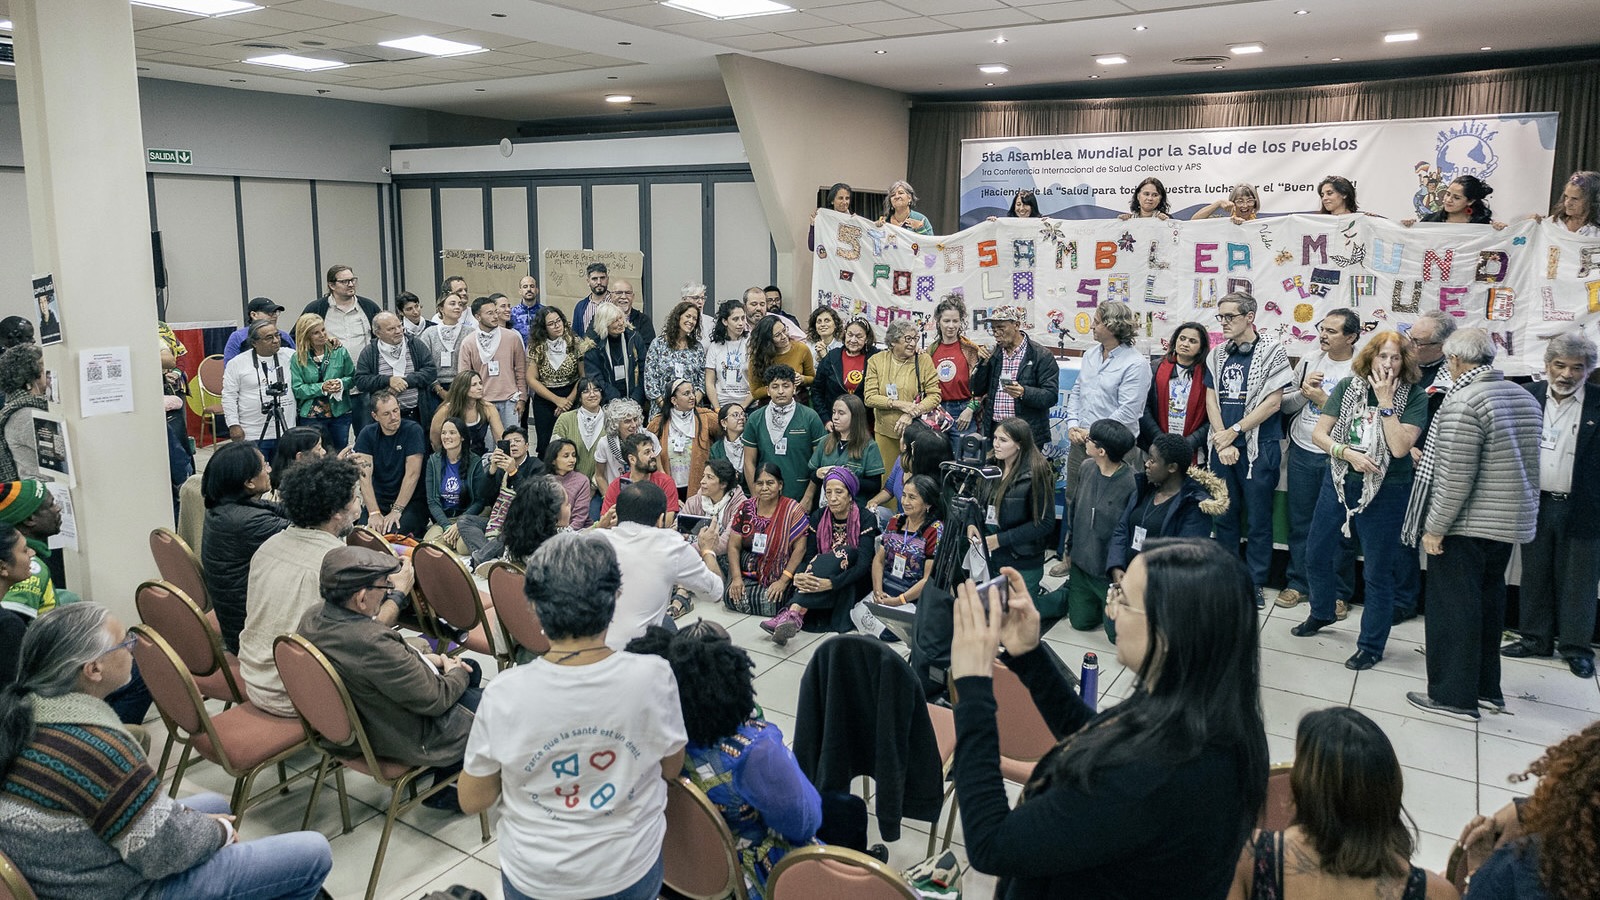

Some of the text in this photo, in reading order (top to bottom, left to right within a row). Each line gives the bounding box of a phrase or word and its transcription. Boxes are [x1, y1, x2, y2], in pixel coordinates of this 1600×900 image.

[150, 152, 175, 160] SALIDA
[981, 138, 1358, 163] 5ta Asamblea Mundial por la Salud de los Pueblos
[981, 163, 1202, 176] 1ra Conferencia Internacional de Salud Colectiva y APS
[981, 188, 1020, 198] ¡Haciend
[1043, 187, 1053, 196] la
[1092, 187, 1117, 197] para
[1119, 185, 1138, 194] tod
[1165, 185, 1201, 194] uestra
[1263, 183, 1274, 192] el
[944, 238, 1252, 274] ASAMBLEA
[870, 263, 935, 302] POR
[981, 271, 1034, 301] LA
[543, 737, 560, 751] que
[560, 731, 570, 741] la
[572, 726, 598, 737] santé
[600, 729, 614, 738] est
[614, 732, 626, 742] un
[625, 740, 641, 761] droit
